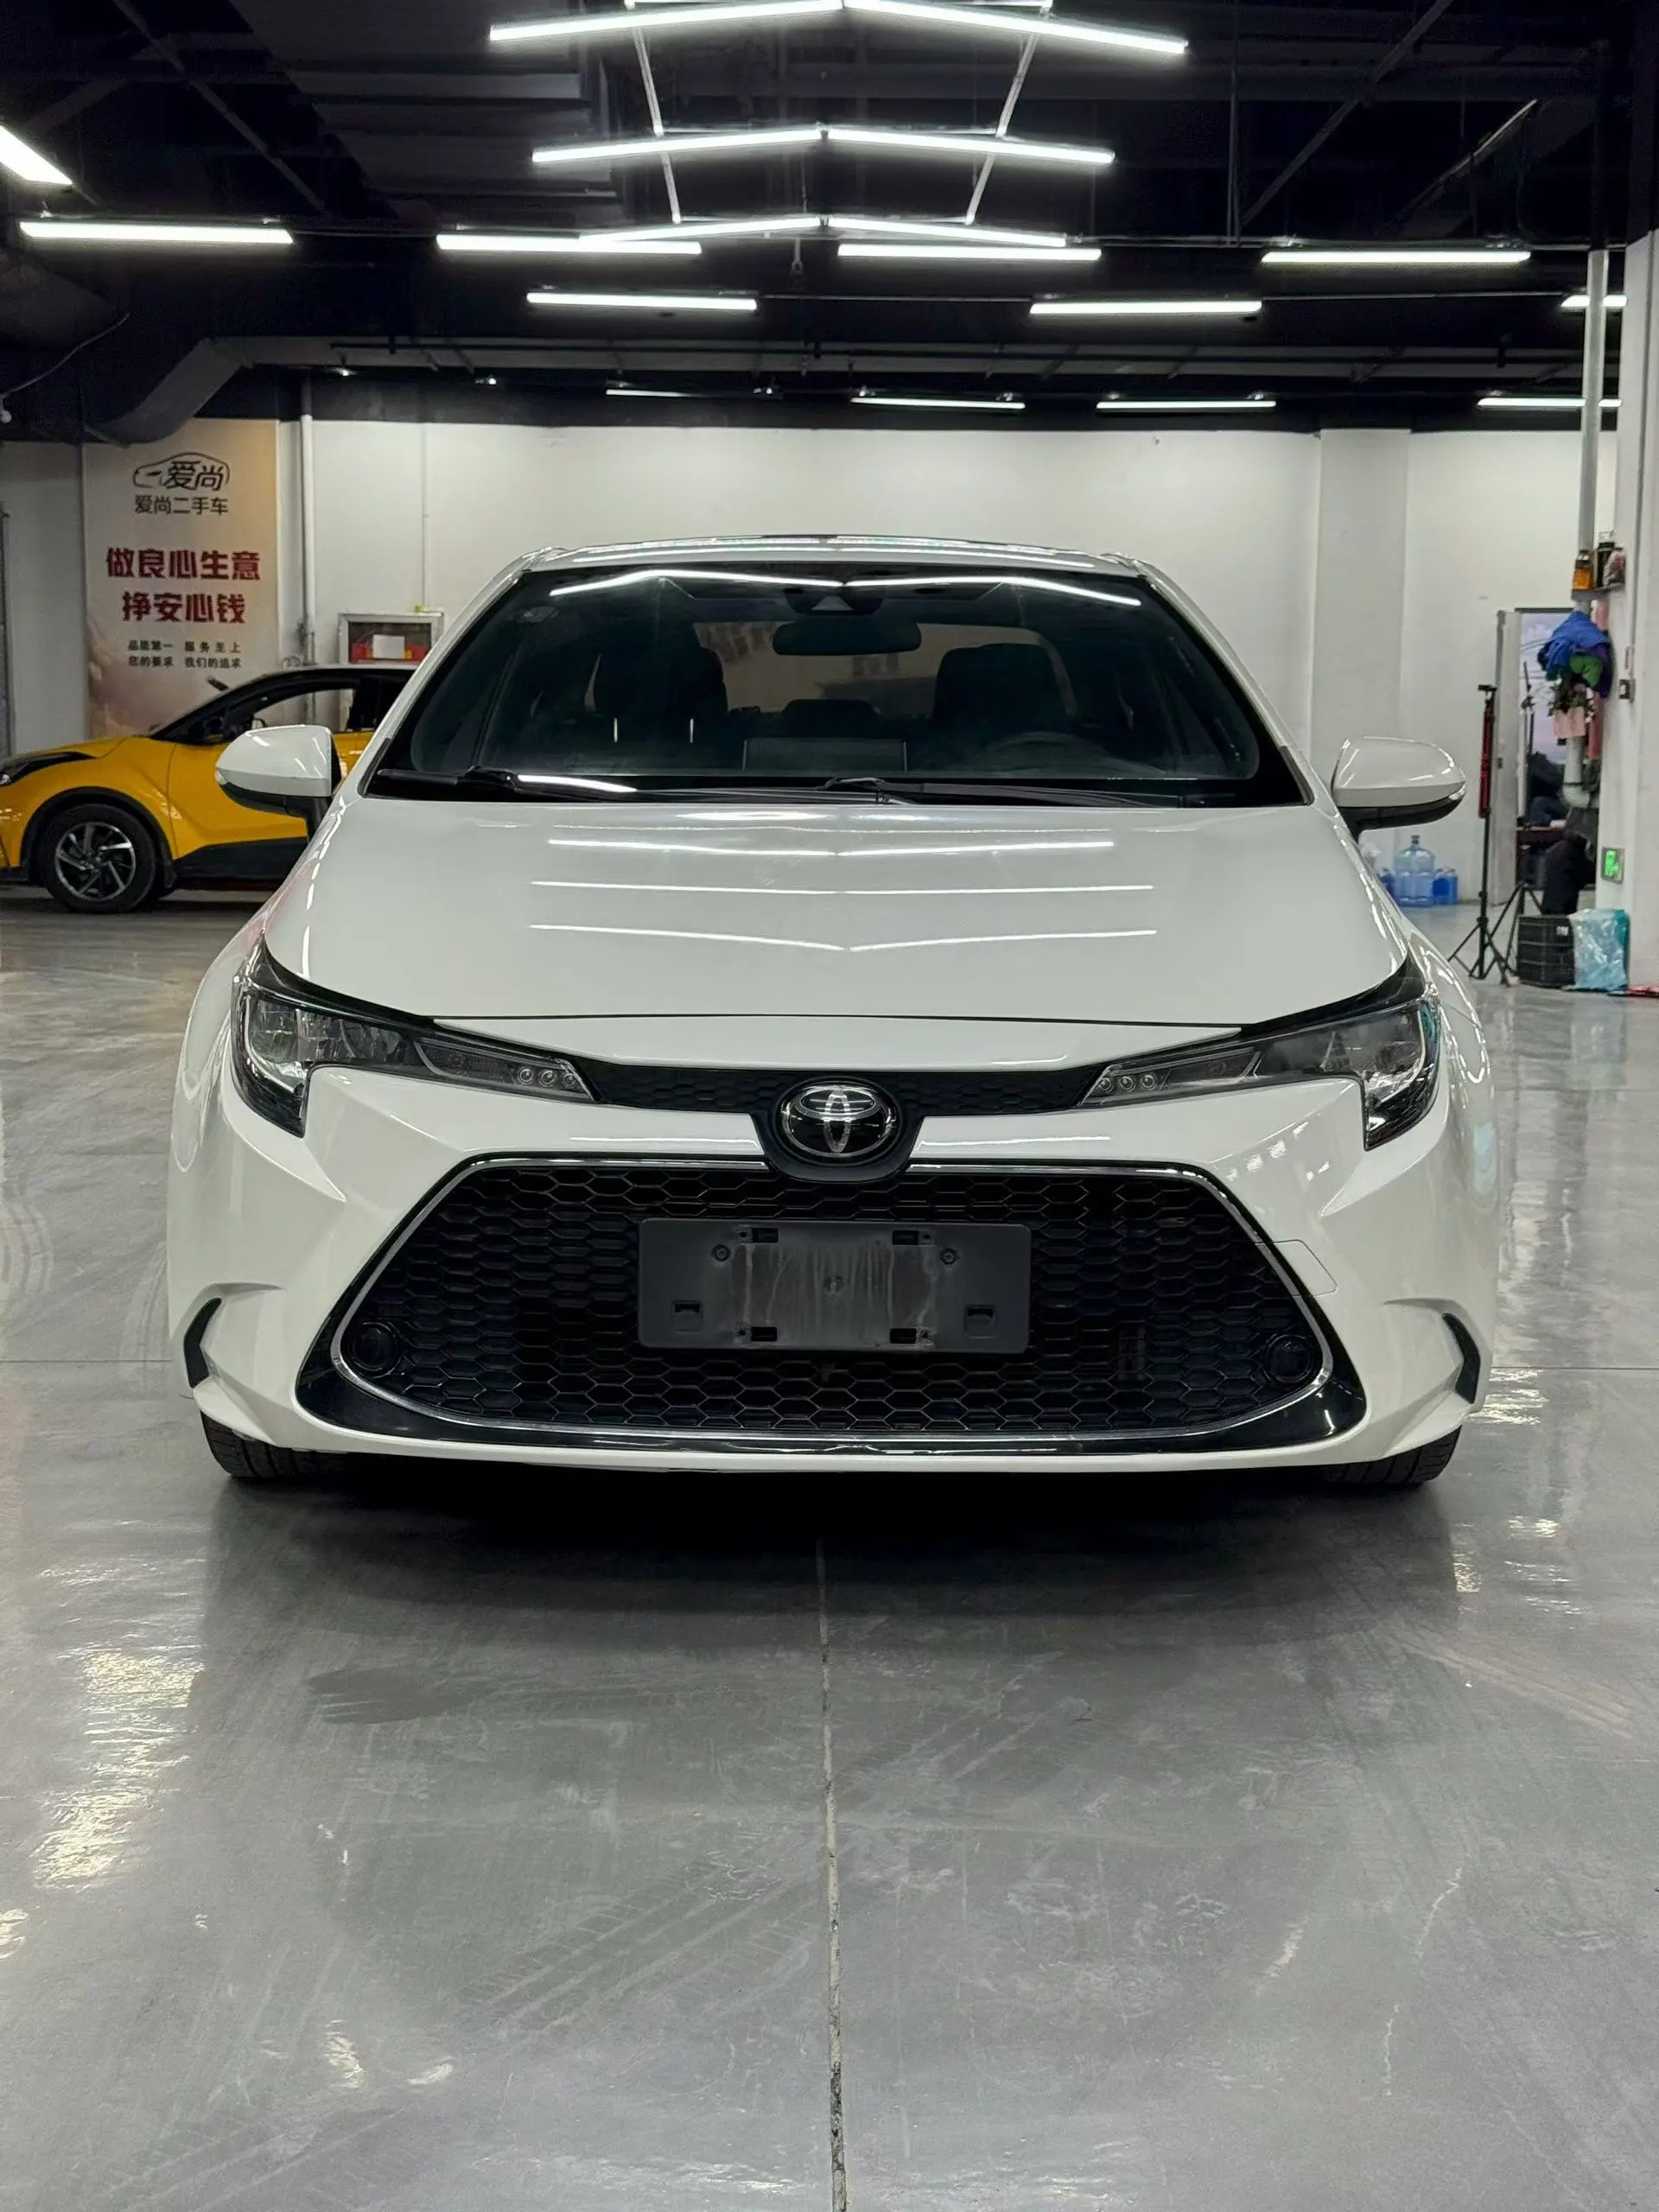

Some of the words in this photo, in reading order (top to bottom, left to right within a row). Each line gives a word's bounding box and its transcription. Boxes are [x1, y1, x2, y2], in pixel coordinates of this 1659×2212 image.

[165, 460, 224, 491] 爱尚
[135, 495, 229, 515] 爱尚二手车
[106, 547, 261, 581] 做良心生意
[122, 592, 246, 624] 挣安心钱
